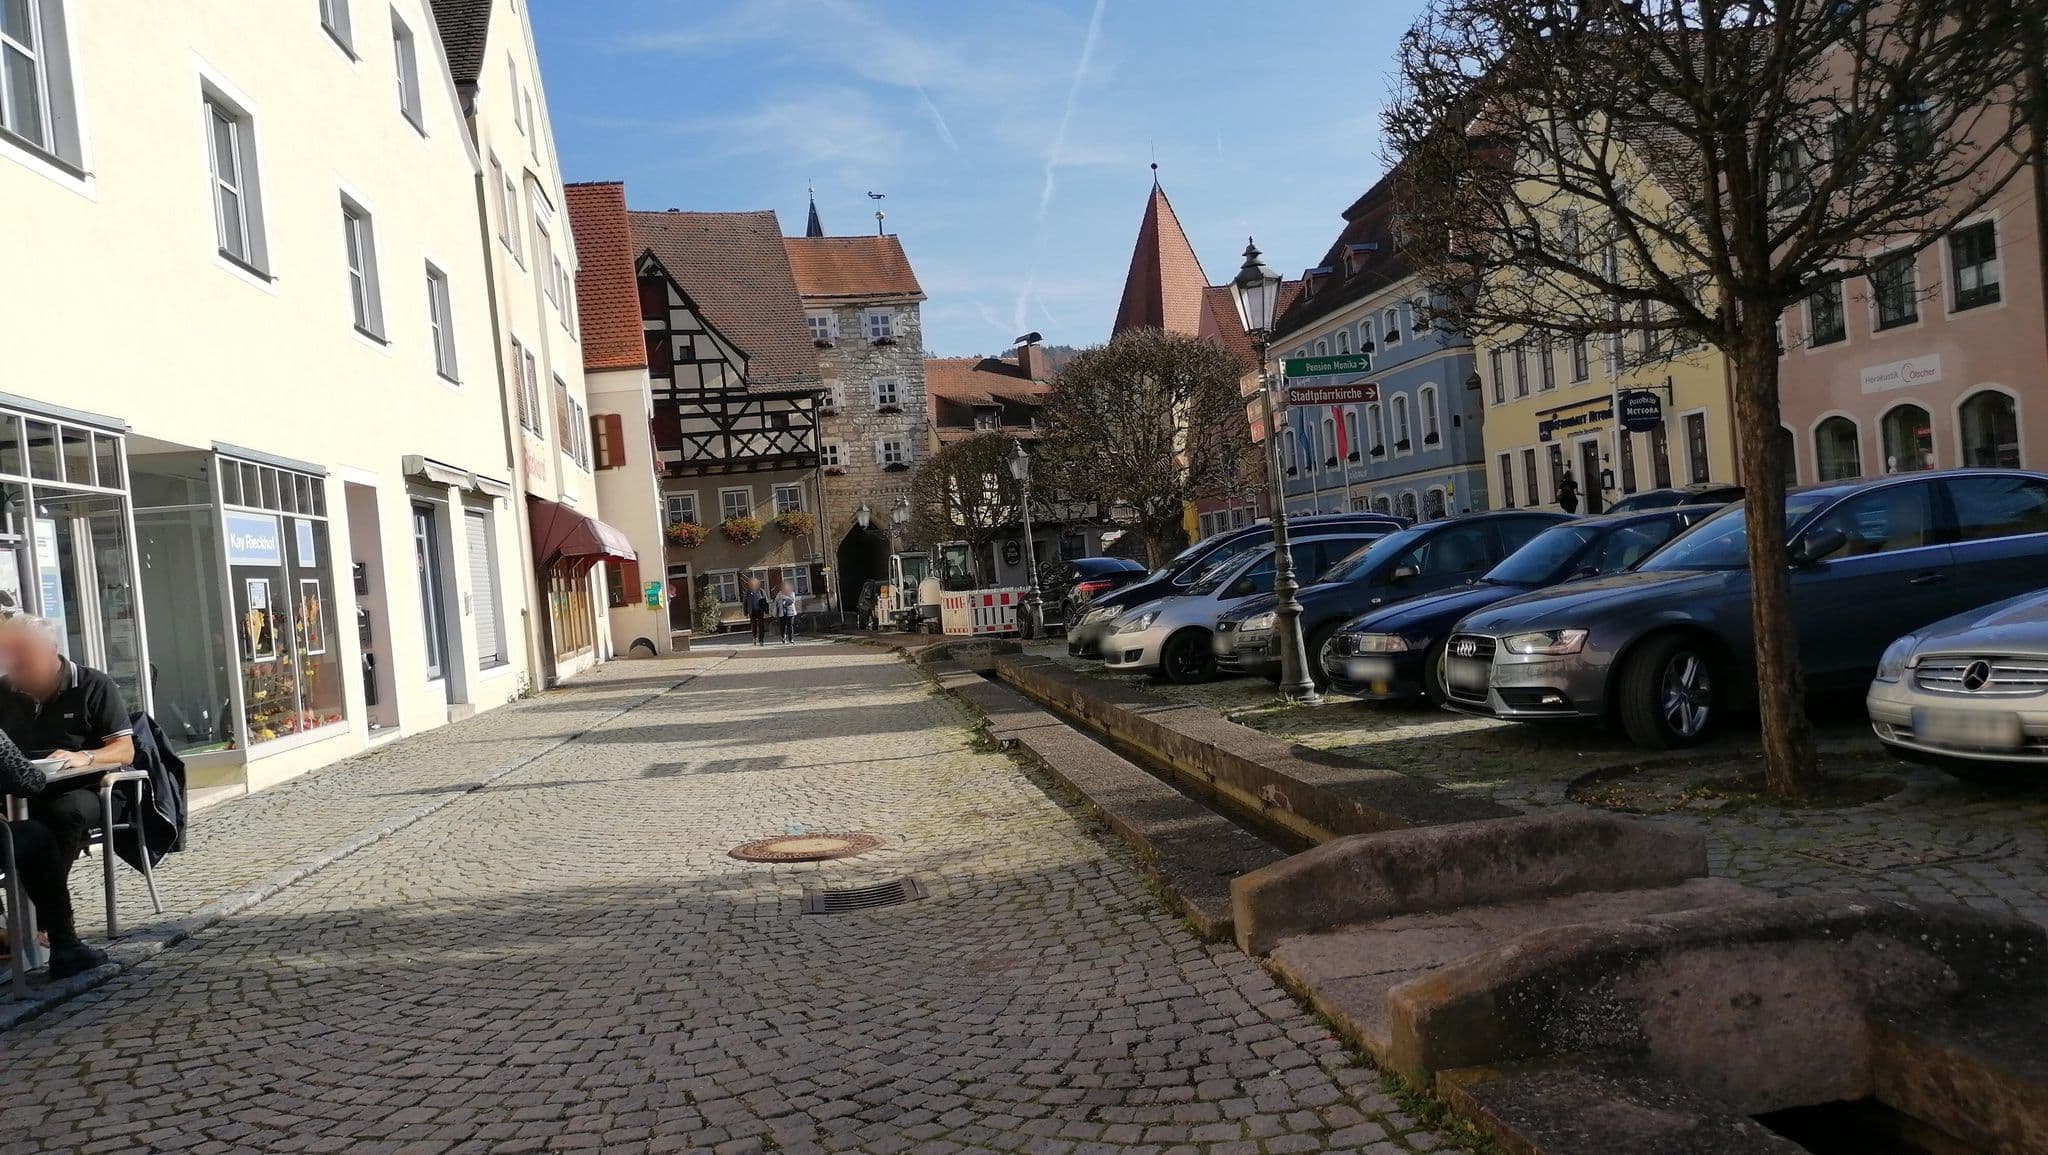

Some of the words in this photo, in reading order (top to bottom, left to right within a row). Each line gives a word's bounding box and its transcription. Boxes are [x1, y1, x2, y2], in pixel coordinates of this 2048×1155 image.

[1306, 361, 1332, 372] Pension
[1333, 360, 1358, 370] Monika
[1290, 387, 1363, 404] Stadtpfarrkirche
[231, 533, 244, 552] Kay
